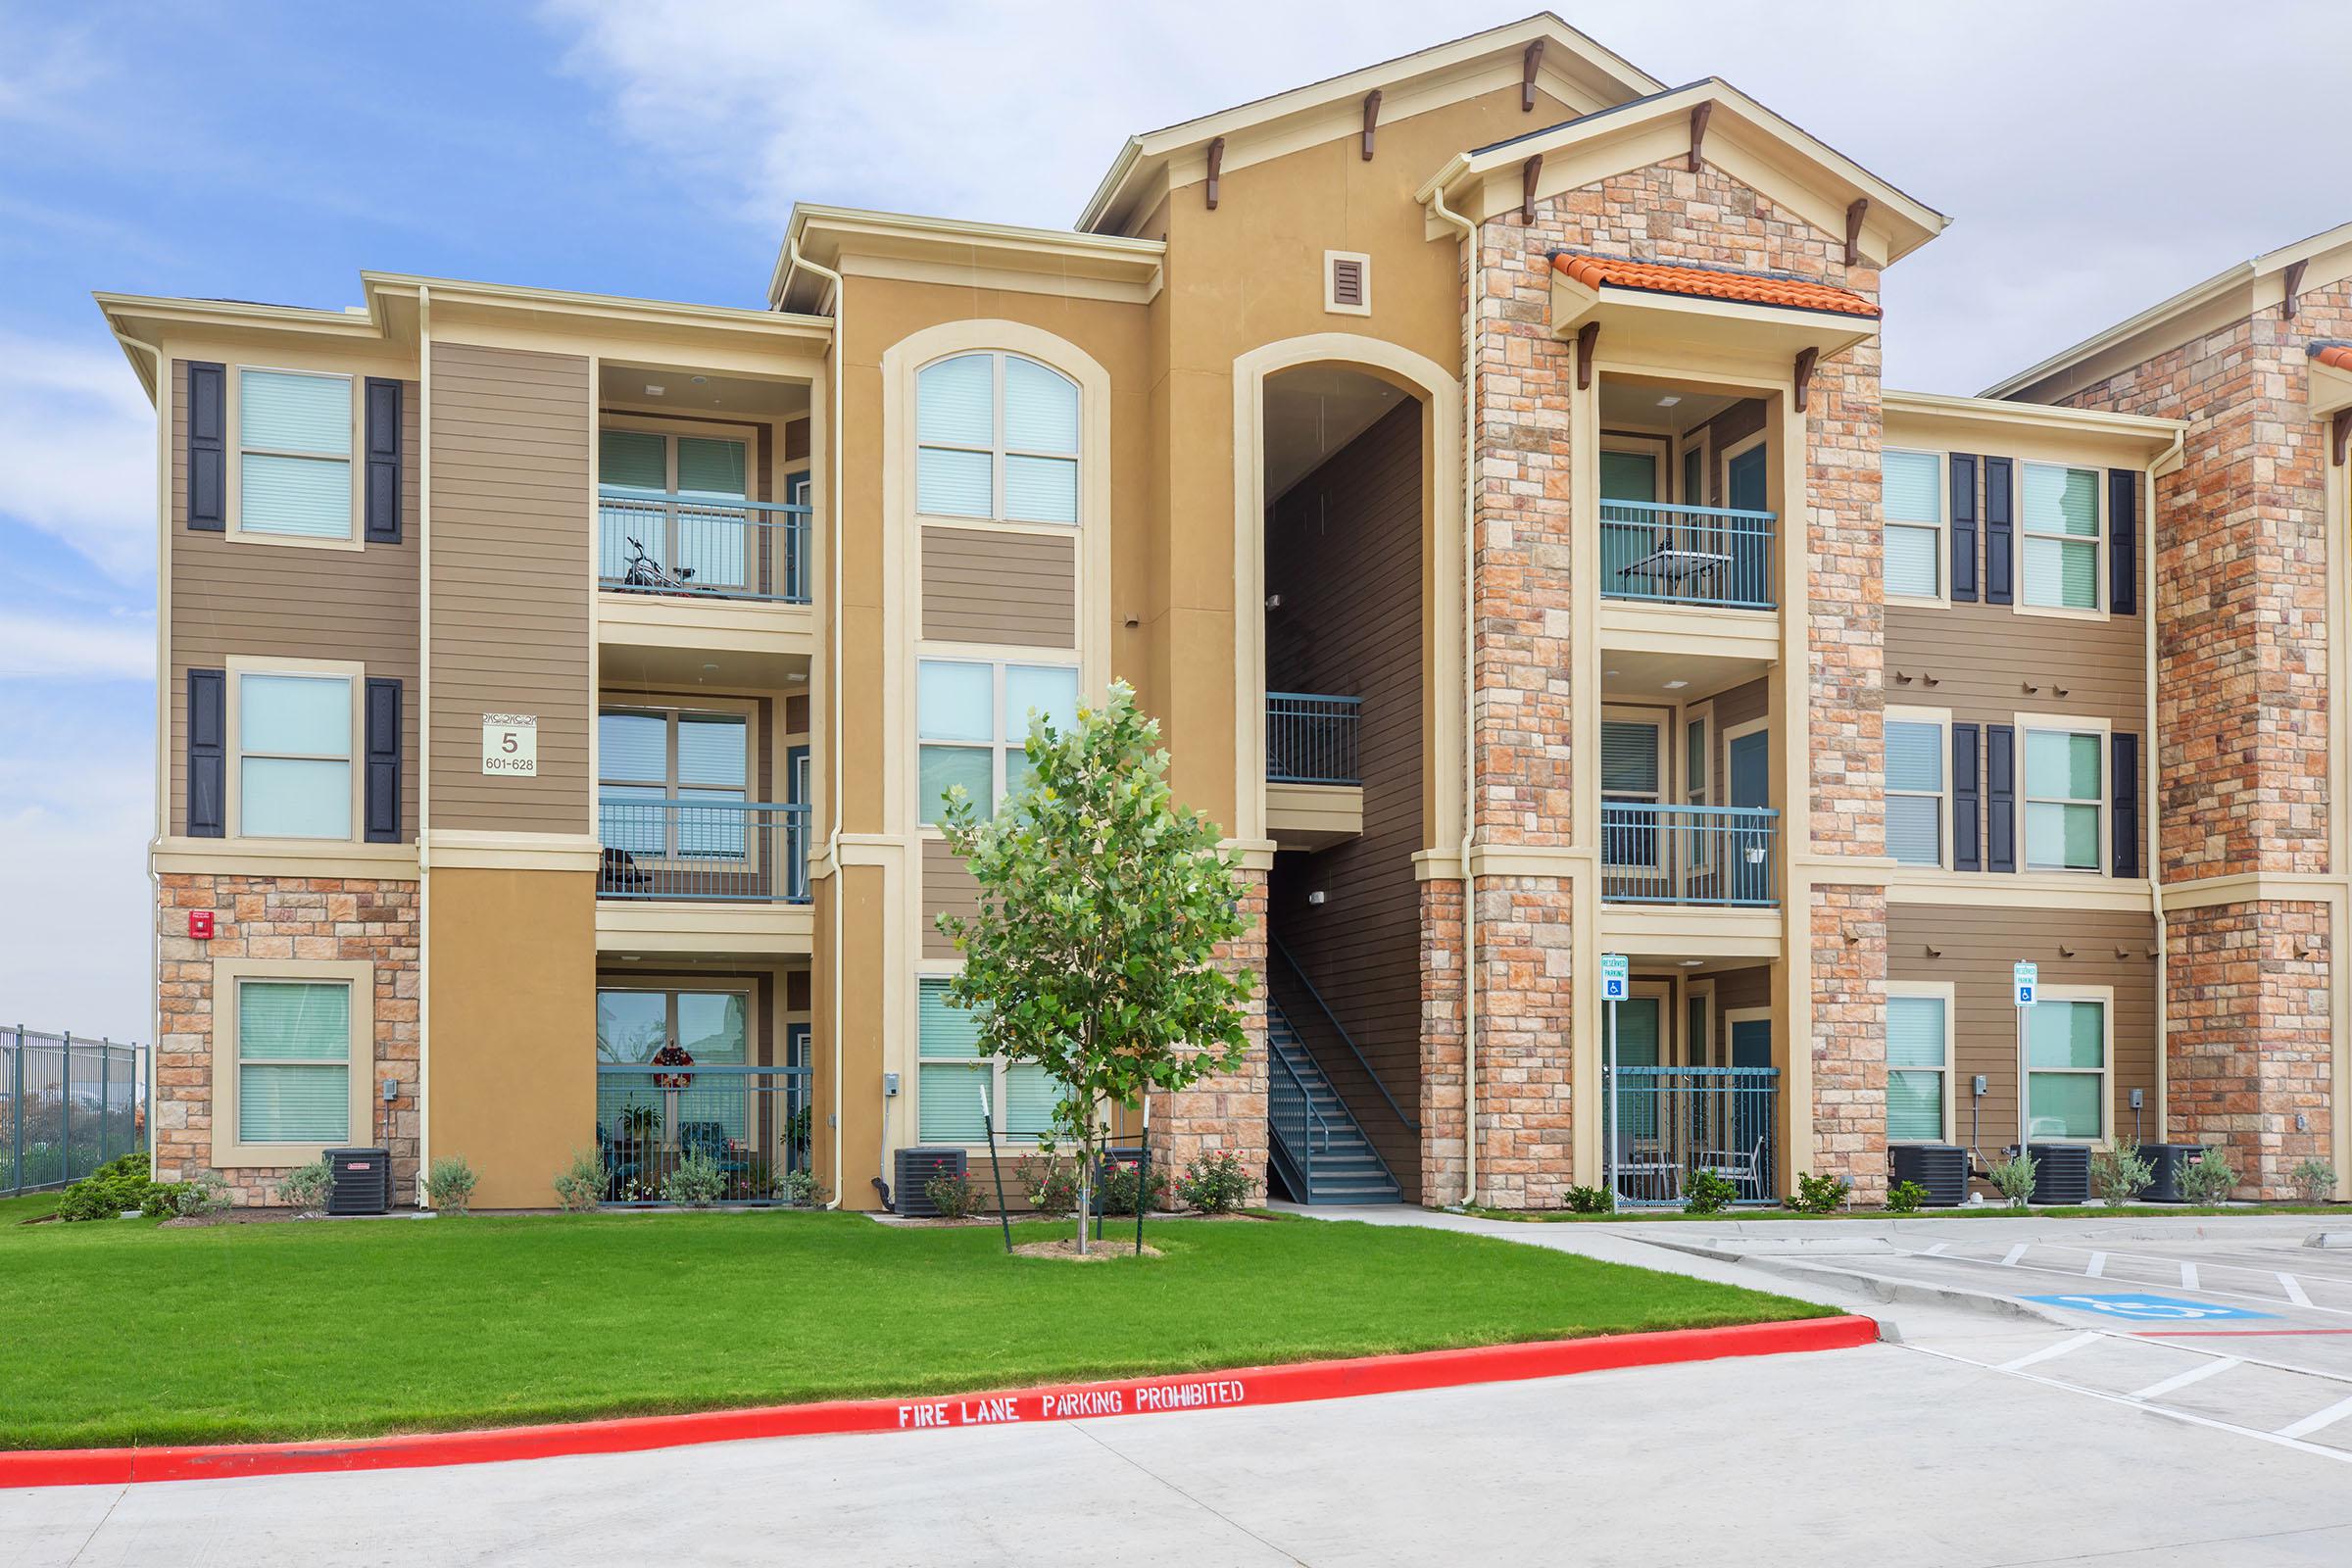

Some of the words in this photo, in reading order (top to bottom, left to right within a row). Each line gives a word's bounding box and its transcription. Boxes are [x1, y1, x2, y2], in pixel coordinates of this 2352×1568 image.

[502, 732, 518, 754] 5
[486, 758, 534, 770] 601-628
[899, 1402, 950, 1427] FIRE
[961, 1397, 1020, 1424] LANE
[1042, 1391, 1123, 1417] PARKING
[1135, 1380, 1245, 1410] PROHIBITED
